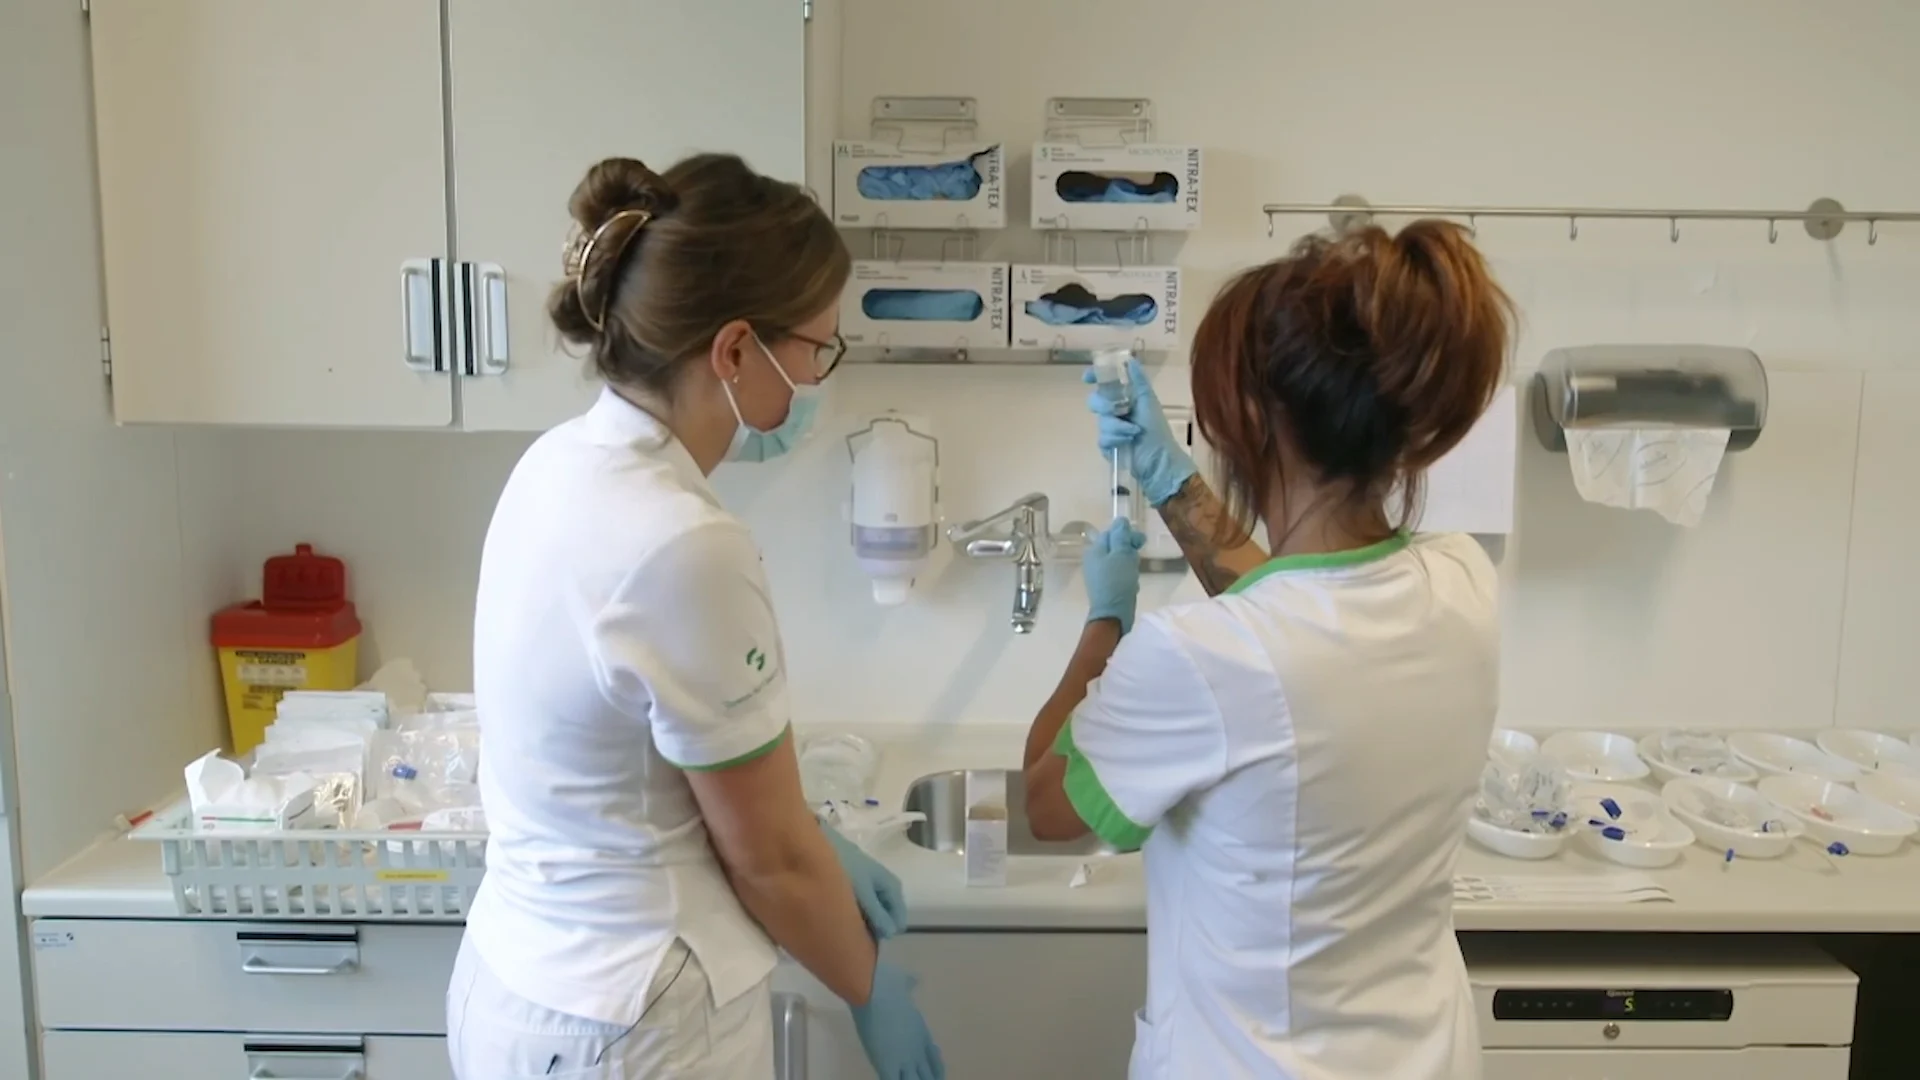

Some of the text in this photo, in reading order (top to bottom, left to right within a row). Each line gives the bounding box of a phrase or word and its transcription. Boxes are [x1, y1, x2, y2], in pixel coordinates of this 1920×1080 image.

[837, 145, 849, 154] XL
[1186, 148, 1199, 213] NITRA-TEX
[990, 266, 1003, 330] NITRA-TEX
[1164, 270, 1177, 334] NITRA-TEX
